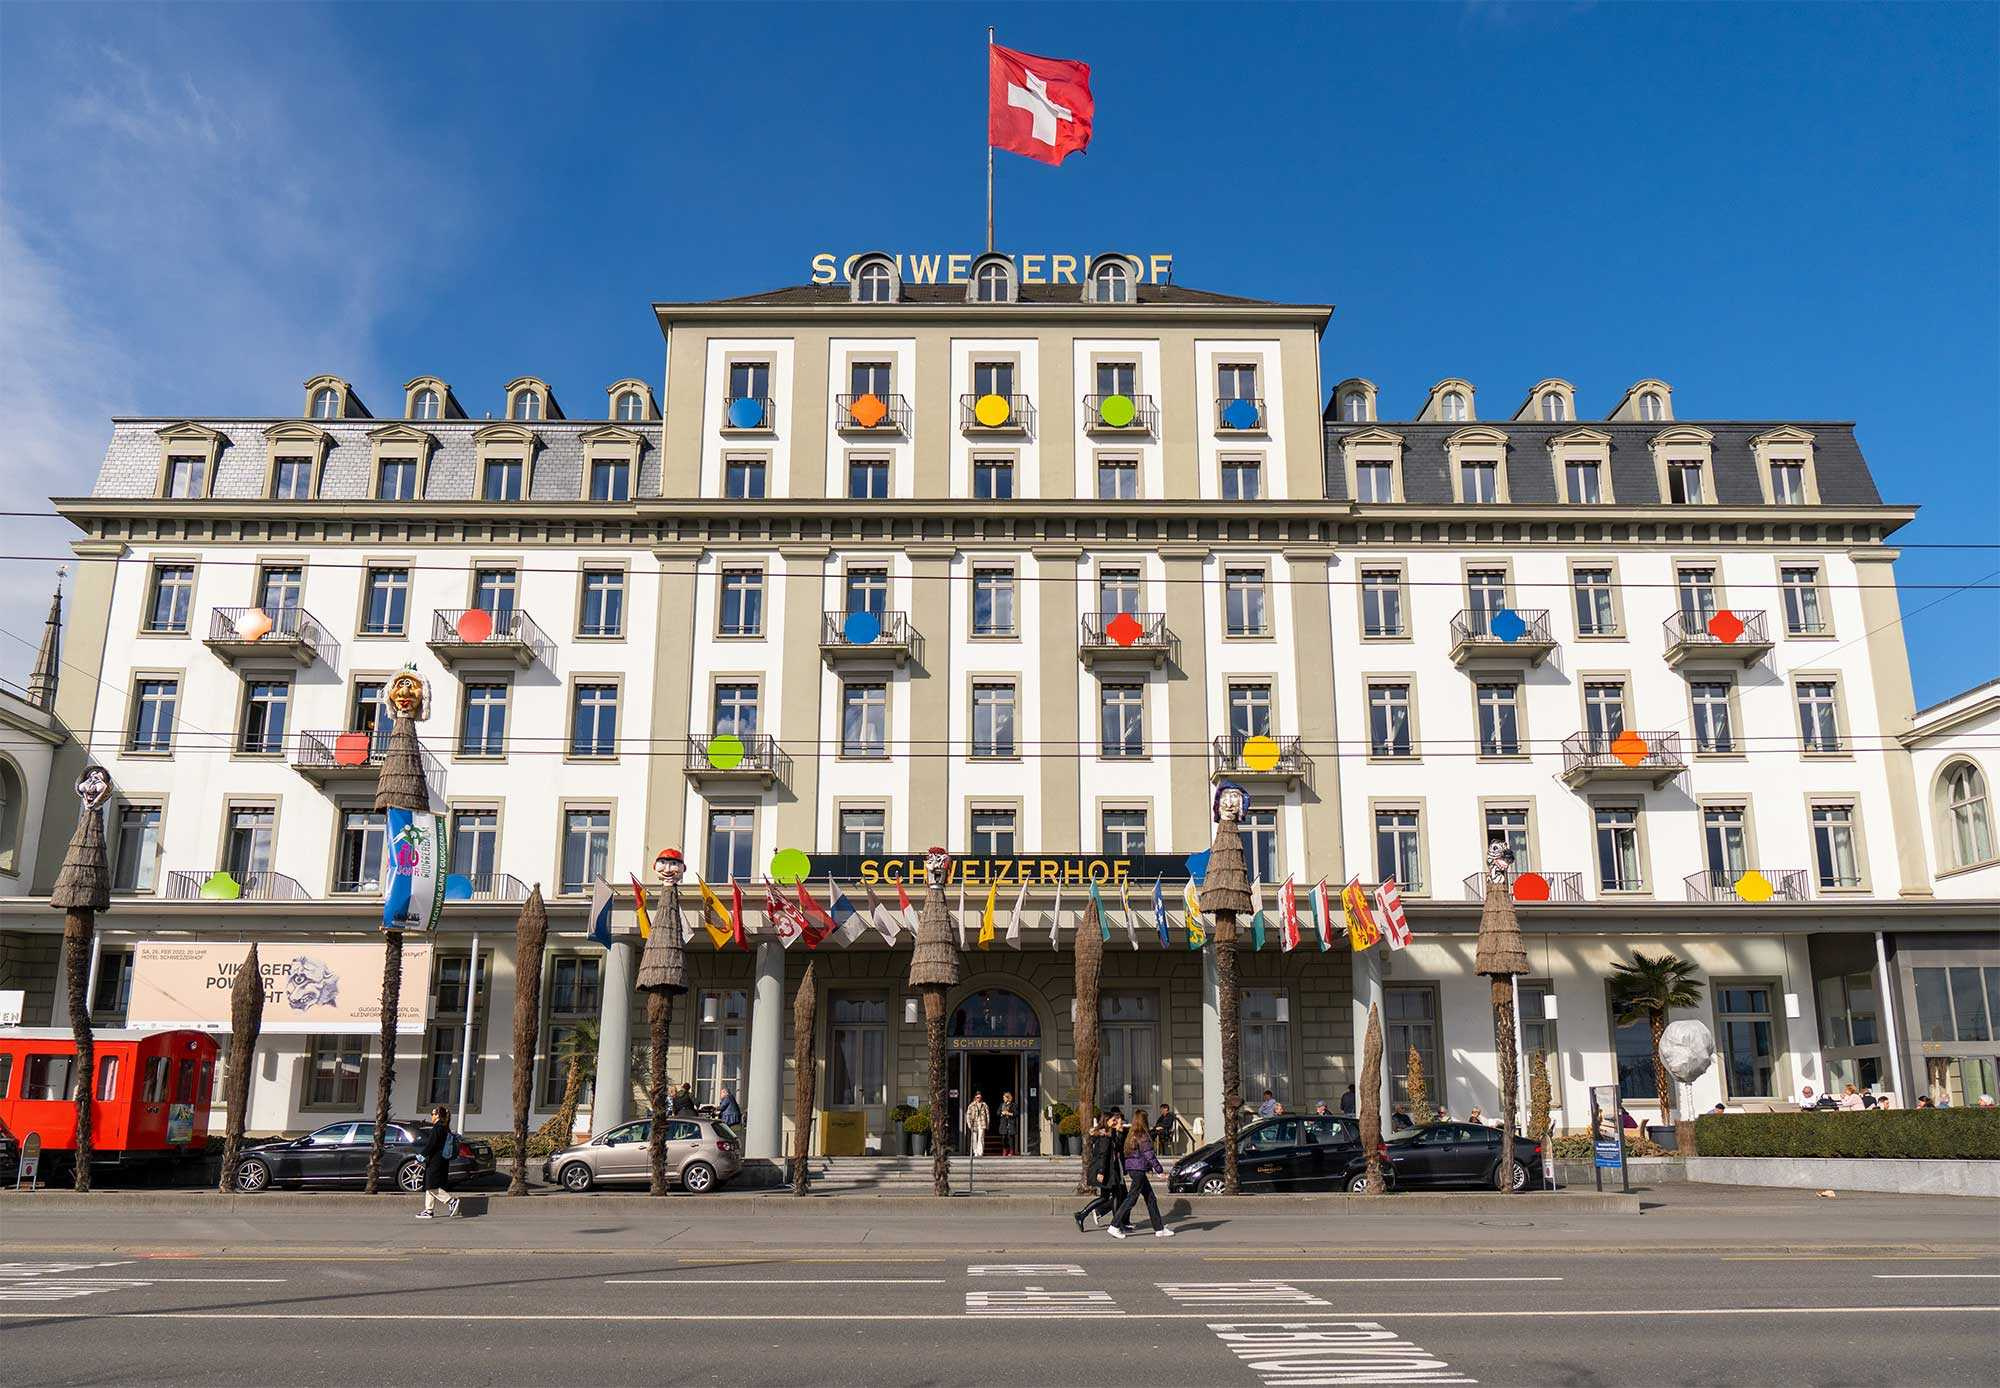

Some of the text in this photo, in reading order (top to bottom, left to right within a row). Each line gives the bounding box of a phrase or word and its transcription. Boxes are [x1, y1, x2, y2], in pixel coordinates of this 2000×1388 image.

[811, 253, 1172, 285] SCWEEROF
[218, 963, 292, 976] VIKGER
[953, 1039, 1035, 1049] SCHWEIZERHOF
[1206, 1321, 1480, 1387] EBIKON
